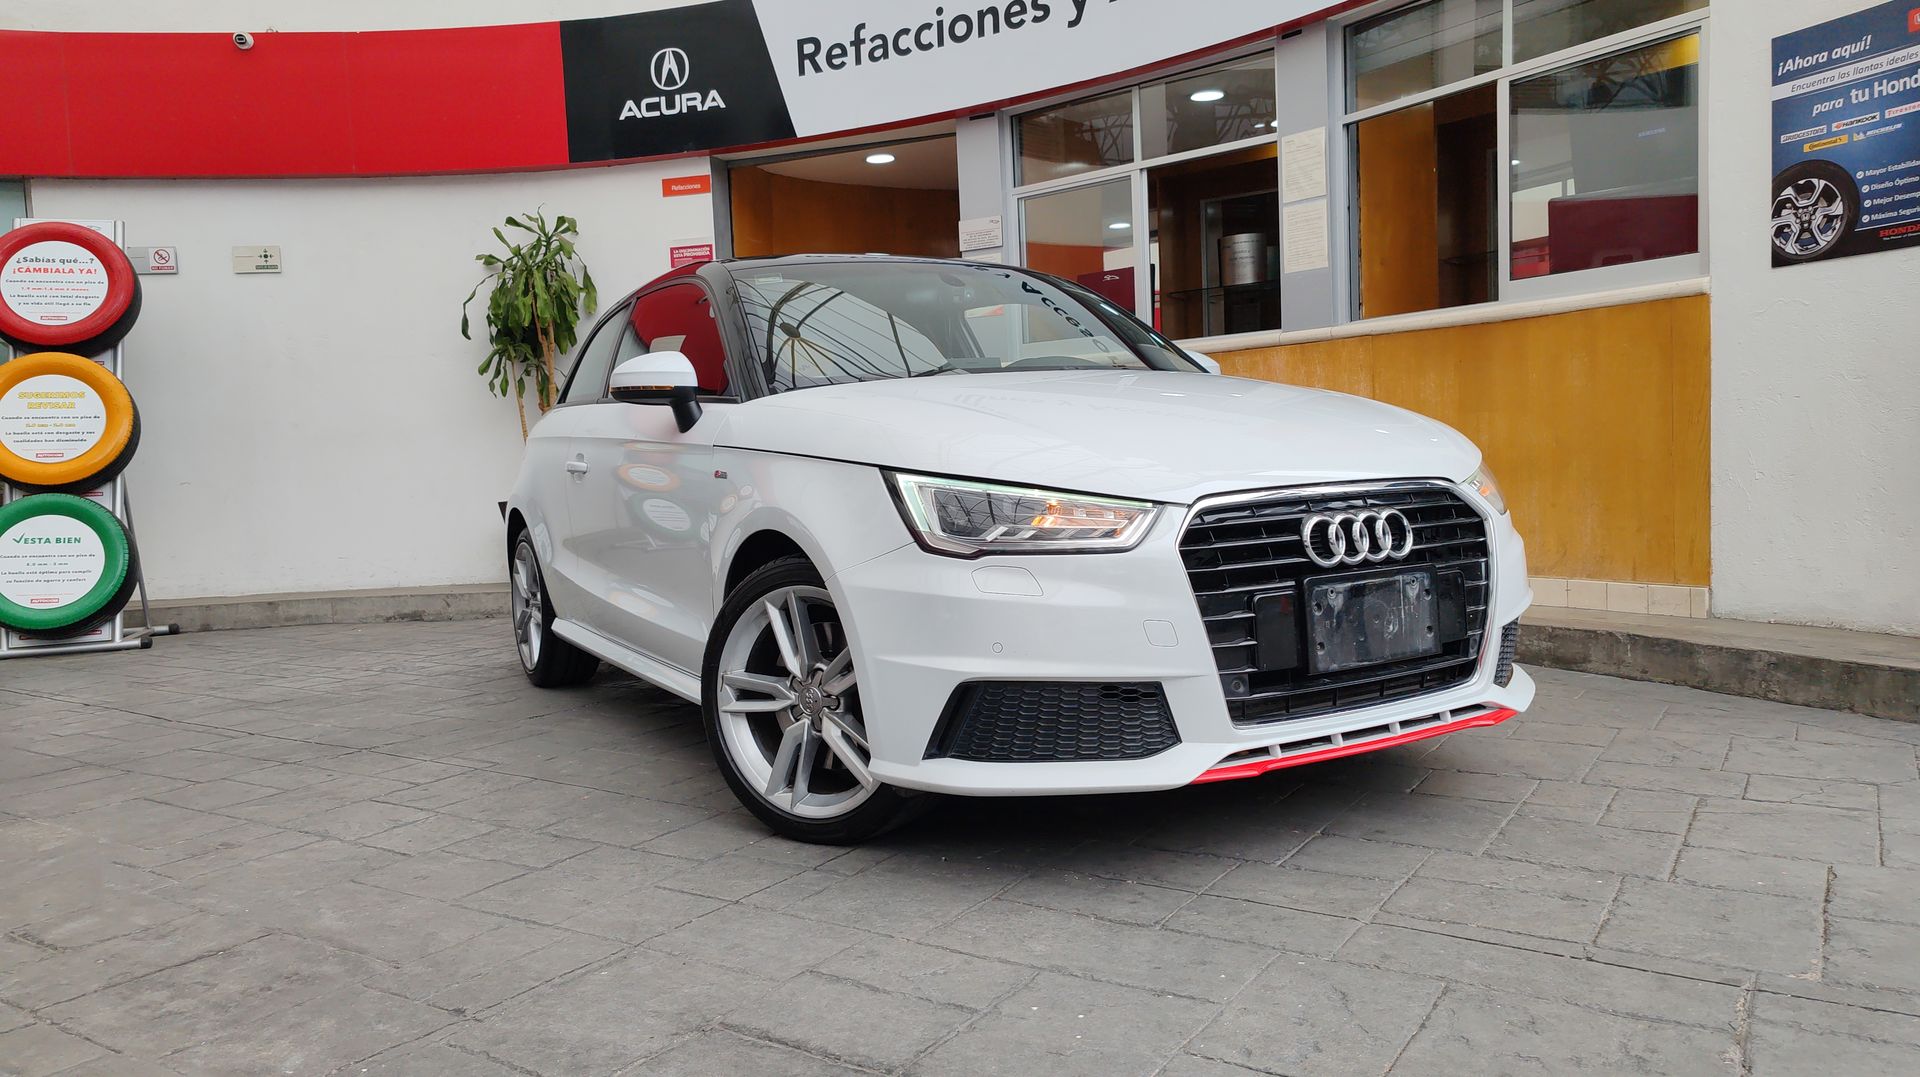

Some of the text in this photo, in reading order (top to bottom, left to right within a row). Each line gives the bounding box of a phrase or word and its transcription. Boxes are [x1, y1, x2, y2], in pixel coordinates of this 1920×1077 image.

[797, 0, 1051, 77] Refacciones
[1777, 34, 1872, 76] ¡Ahora aquí!
[1791, 51, 1919, 93] Encuentra las llantas ideales
[619, 89, 726, 120] ACURA
[1812, 98, 1844, 117] para
[1850, 88, 1869, 104] tu
[1866, 168, 1887, 176] Mayor
[1870, 181, 1894, 190] Diseño
[1873, 196, 1894, 205] Mejor
